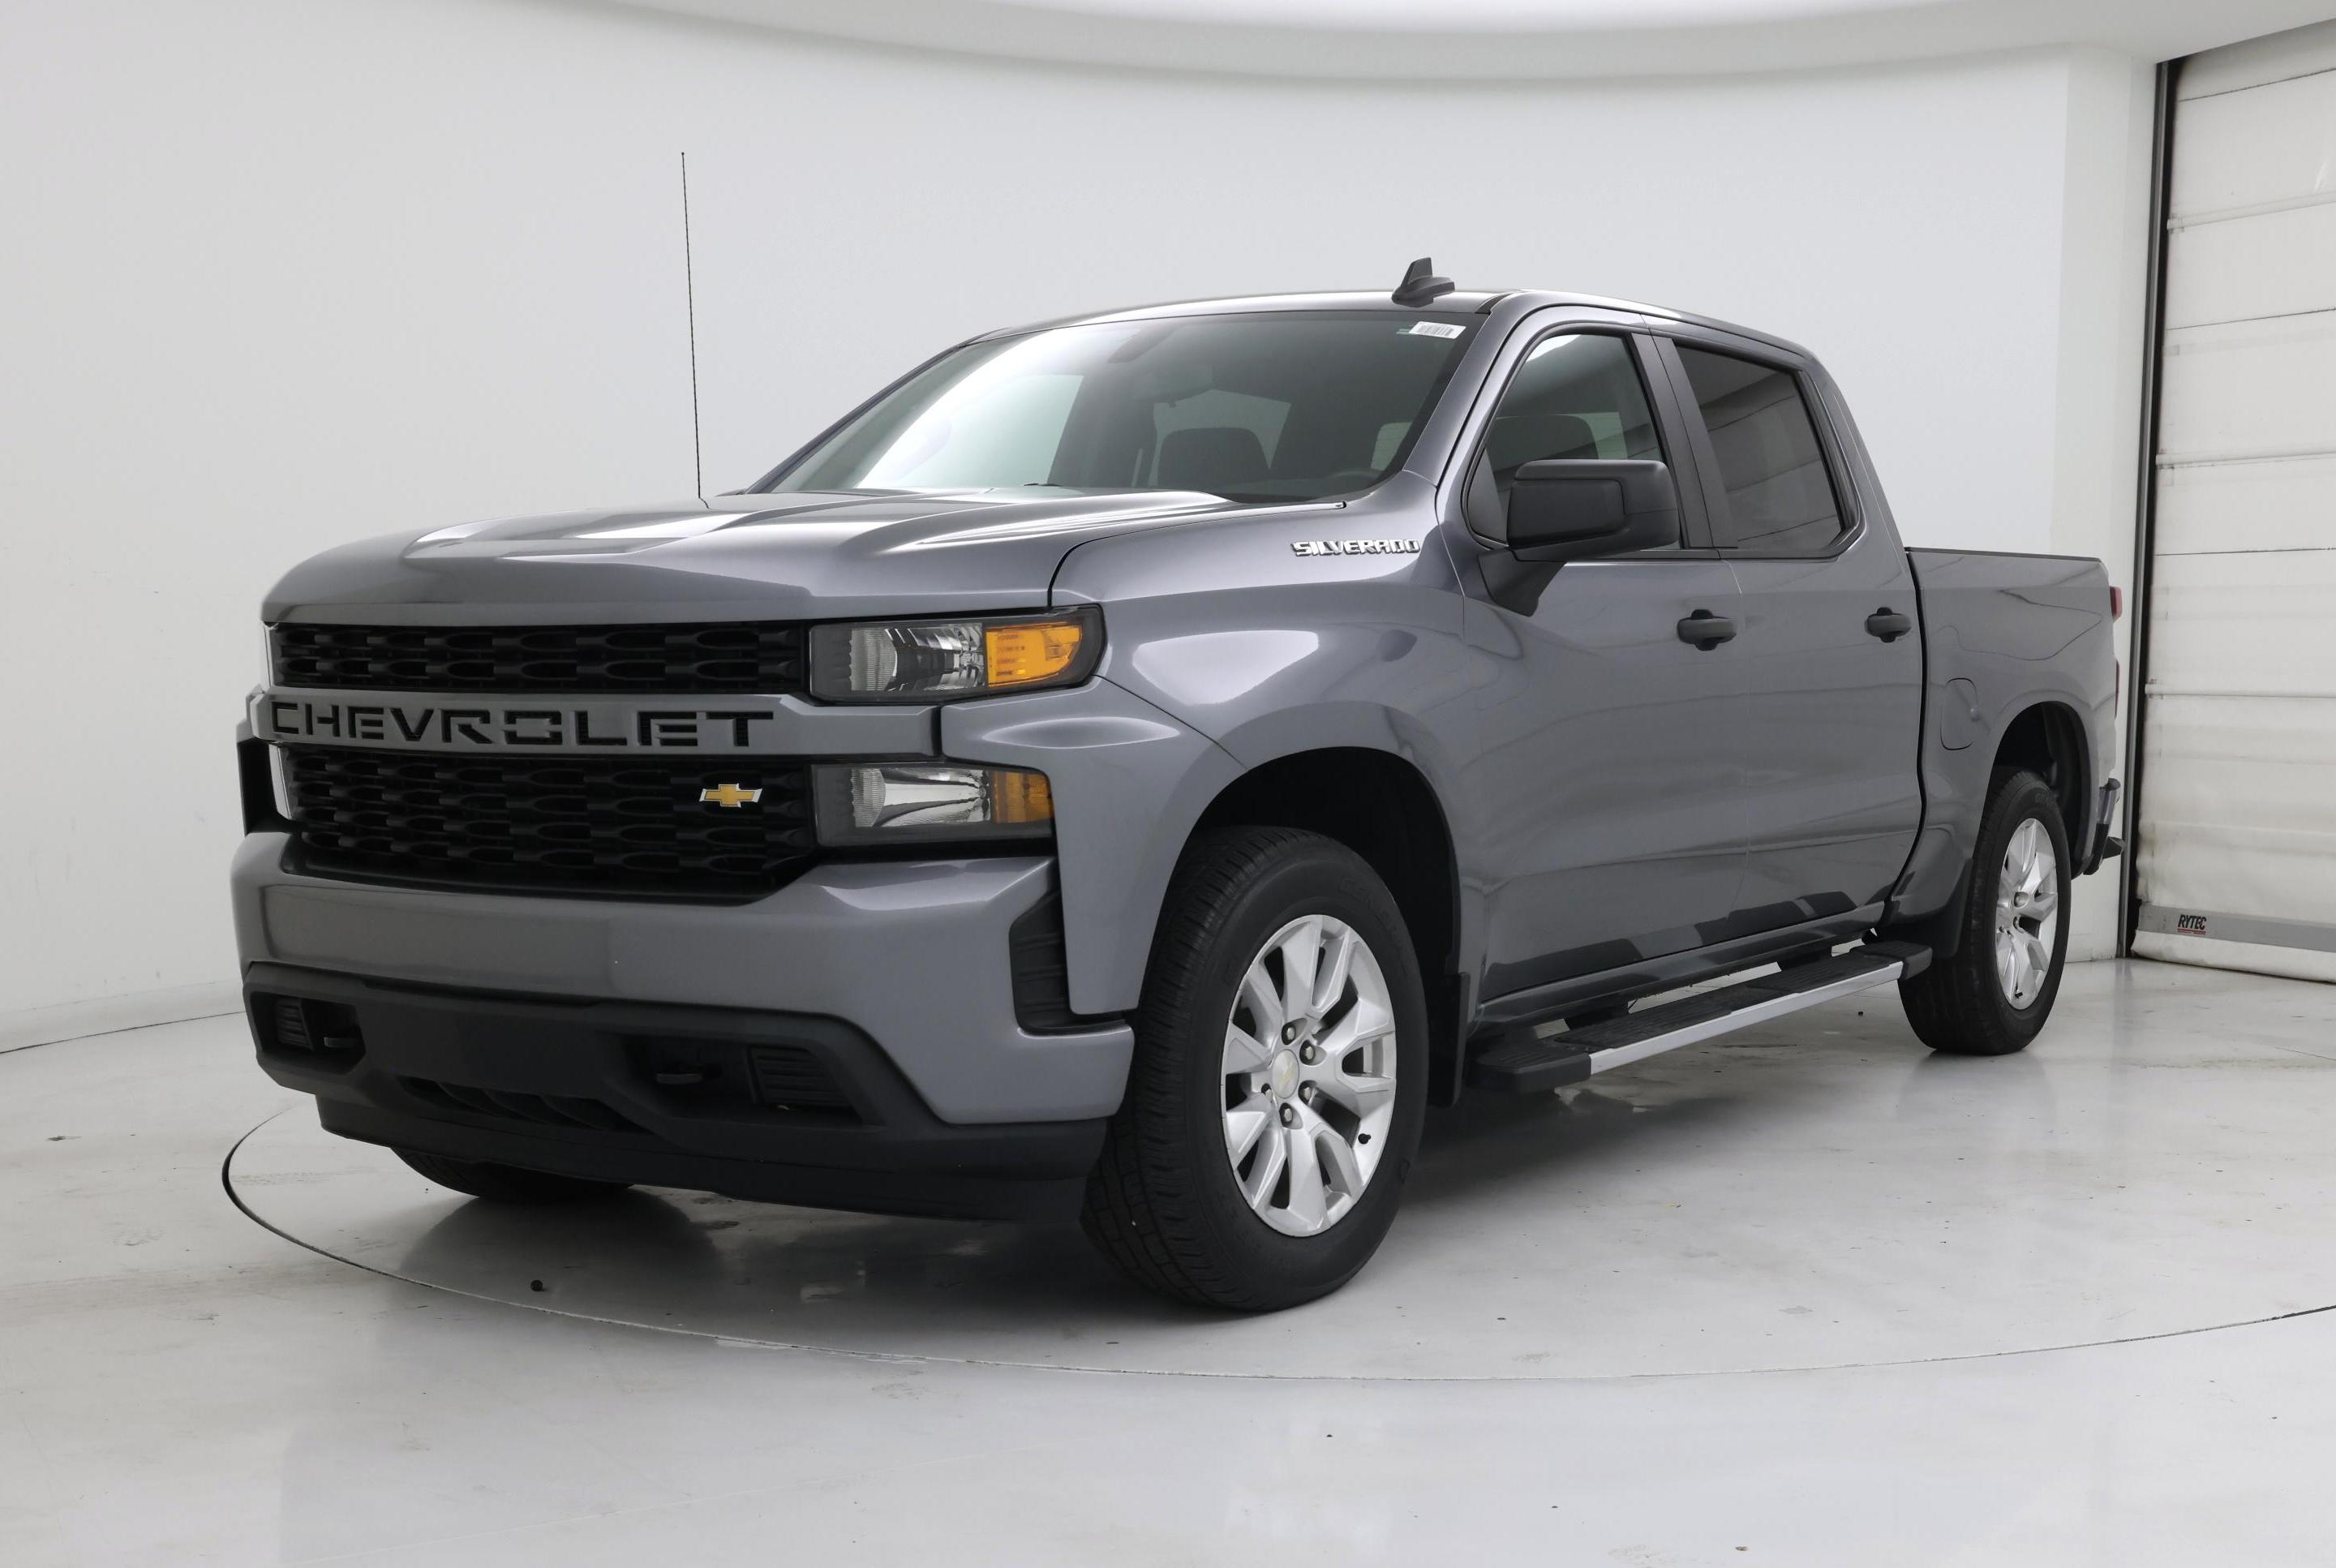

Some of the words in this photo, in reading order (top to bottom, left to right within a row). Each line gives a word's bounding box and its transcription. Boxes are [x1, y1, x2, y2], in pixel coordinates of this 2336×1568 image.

[1291, 539, 1420, 556] SILVERADO
[271, 701, 775, 747] CHEVROLET
[2178, 914, 2206, 930] RYTEC
